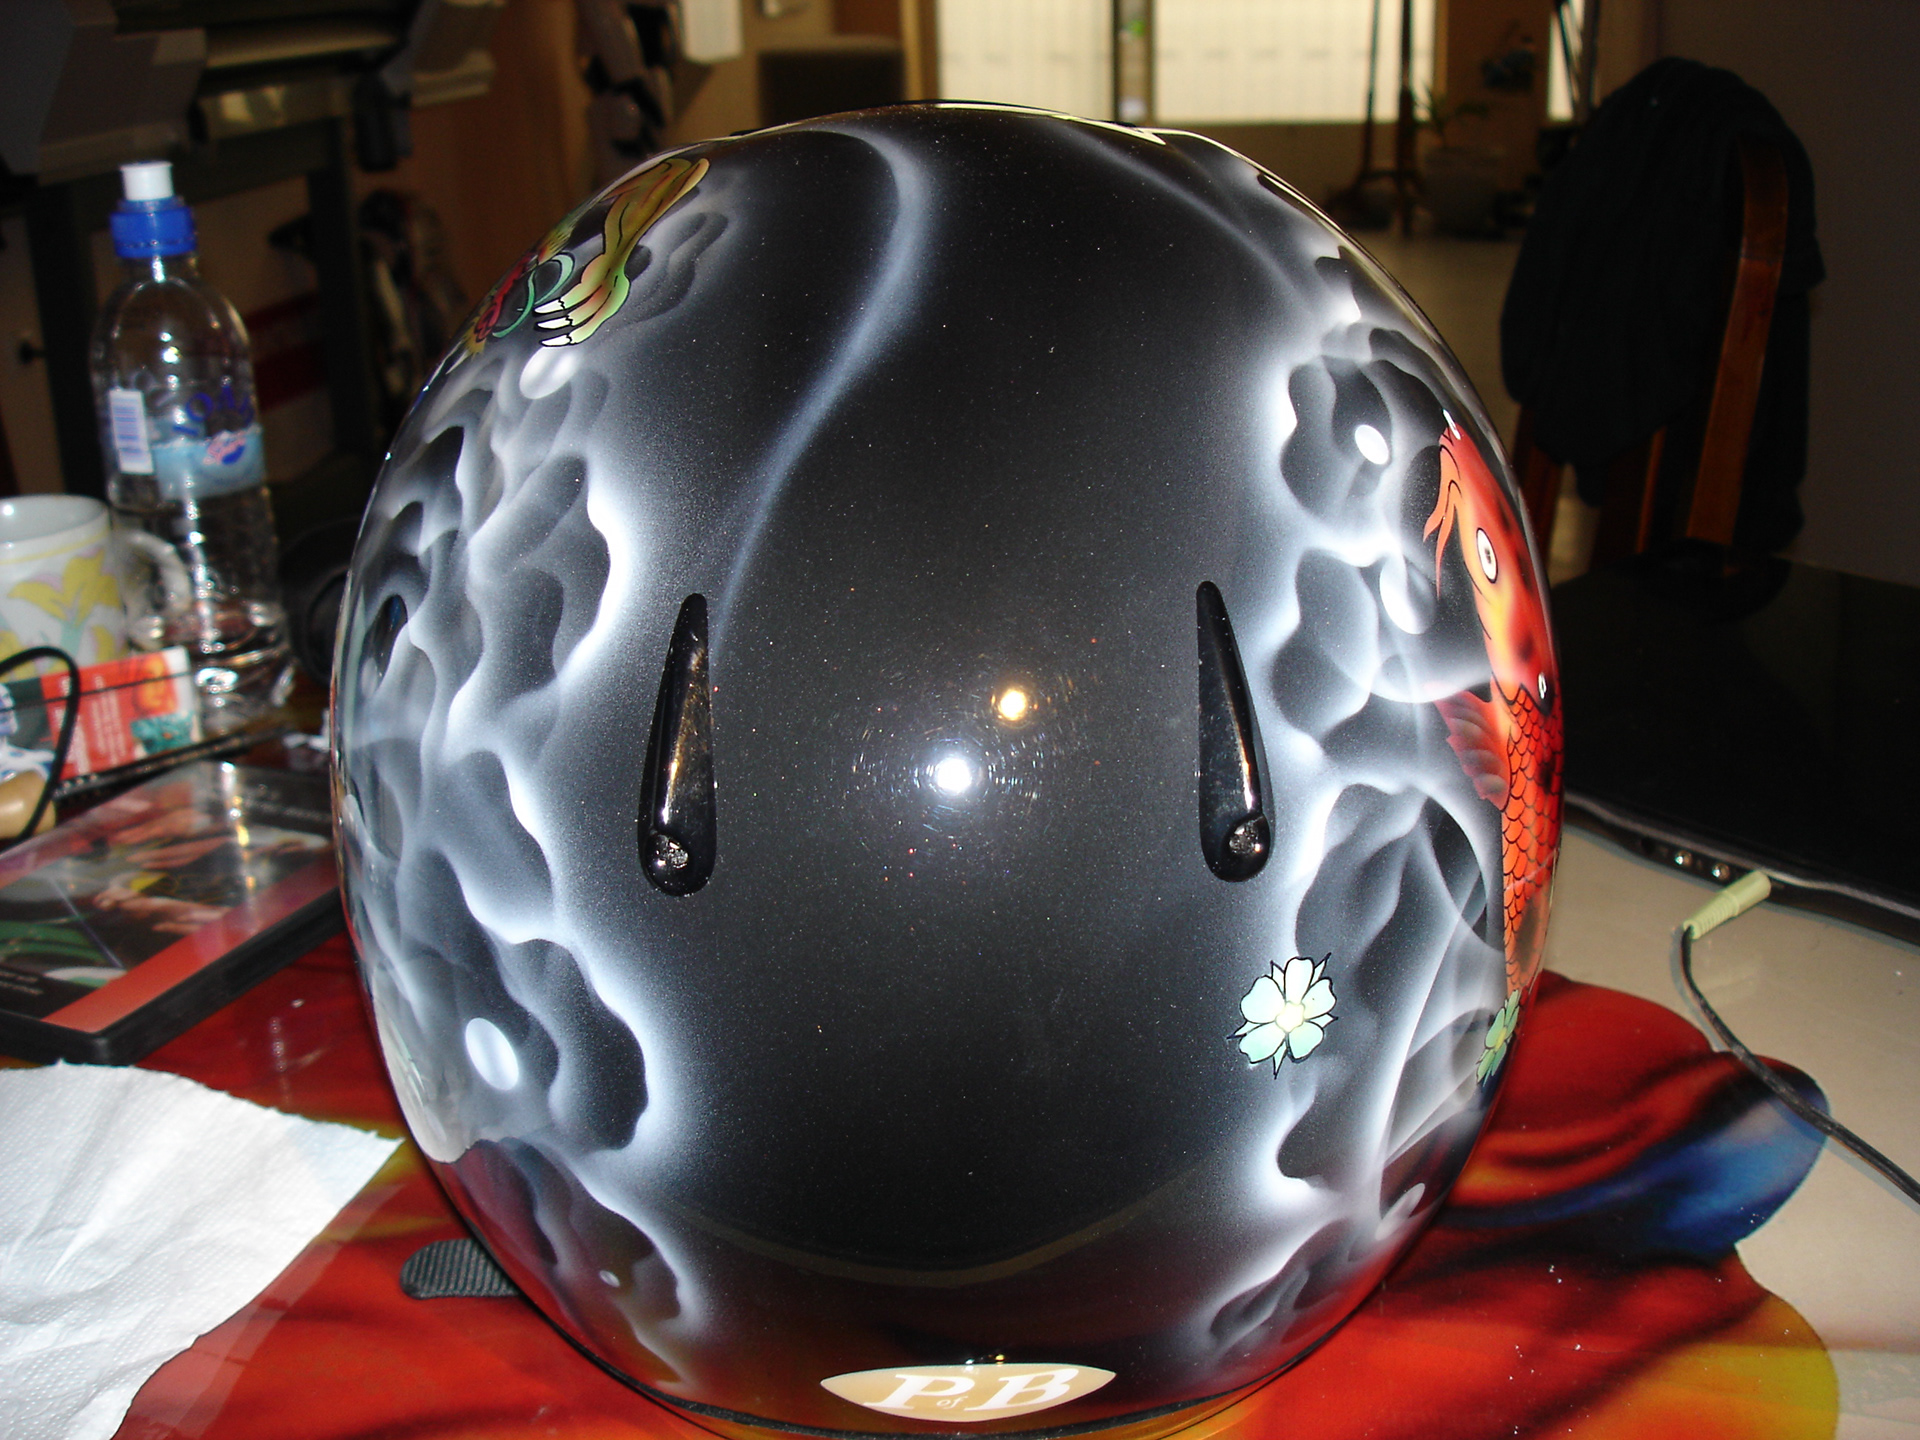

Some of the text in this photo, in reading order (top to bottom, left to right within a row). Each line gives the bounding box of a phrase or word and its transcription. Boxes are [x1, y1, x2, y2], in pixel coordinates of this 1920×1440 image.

[864, 1368, 1079, 1411] P of B
